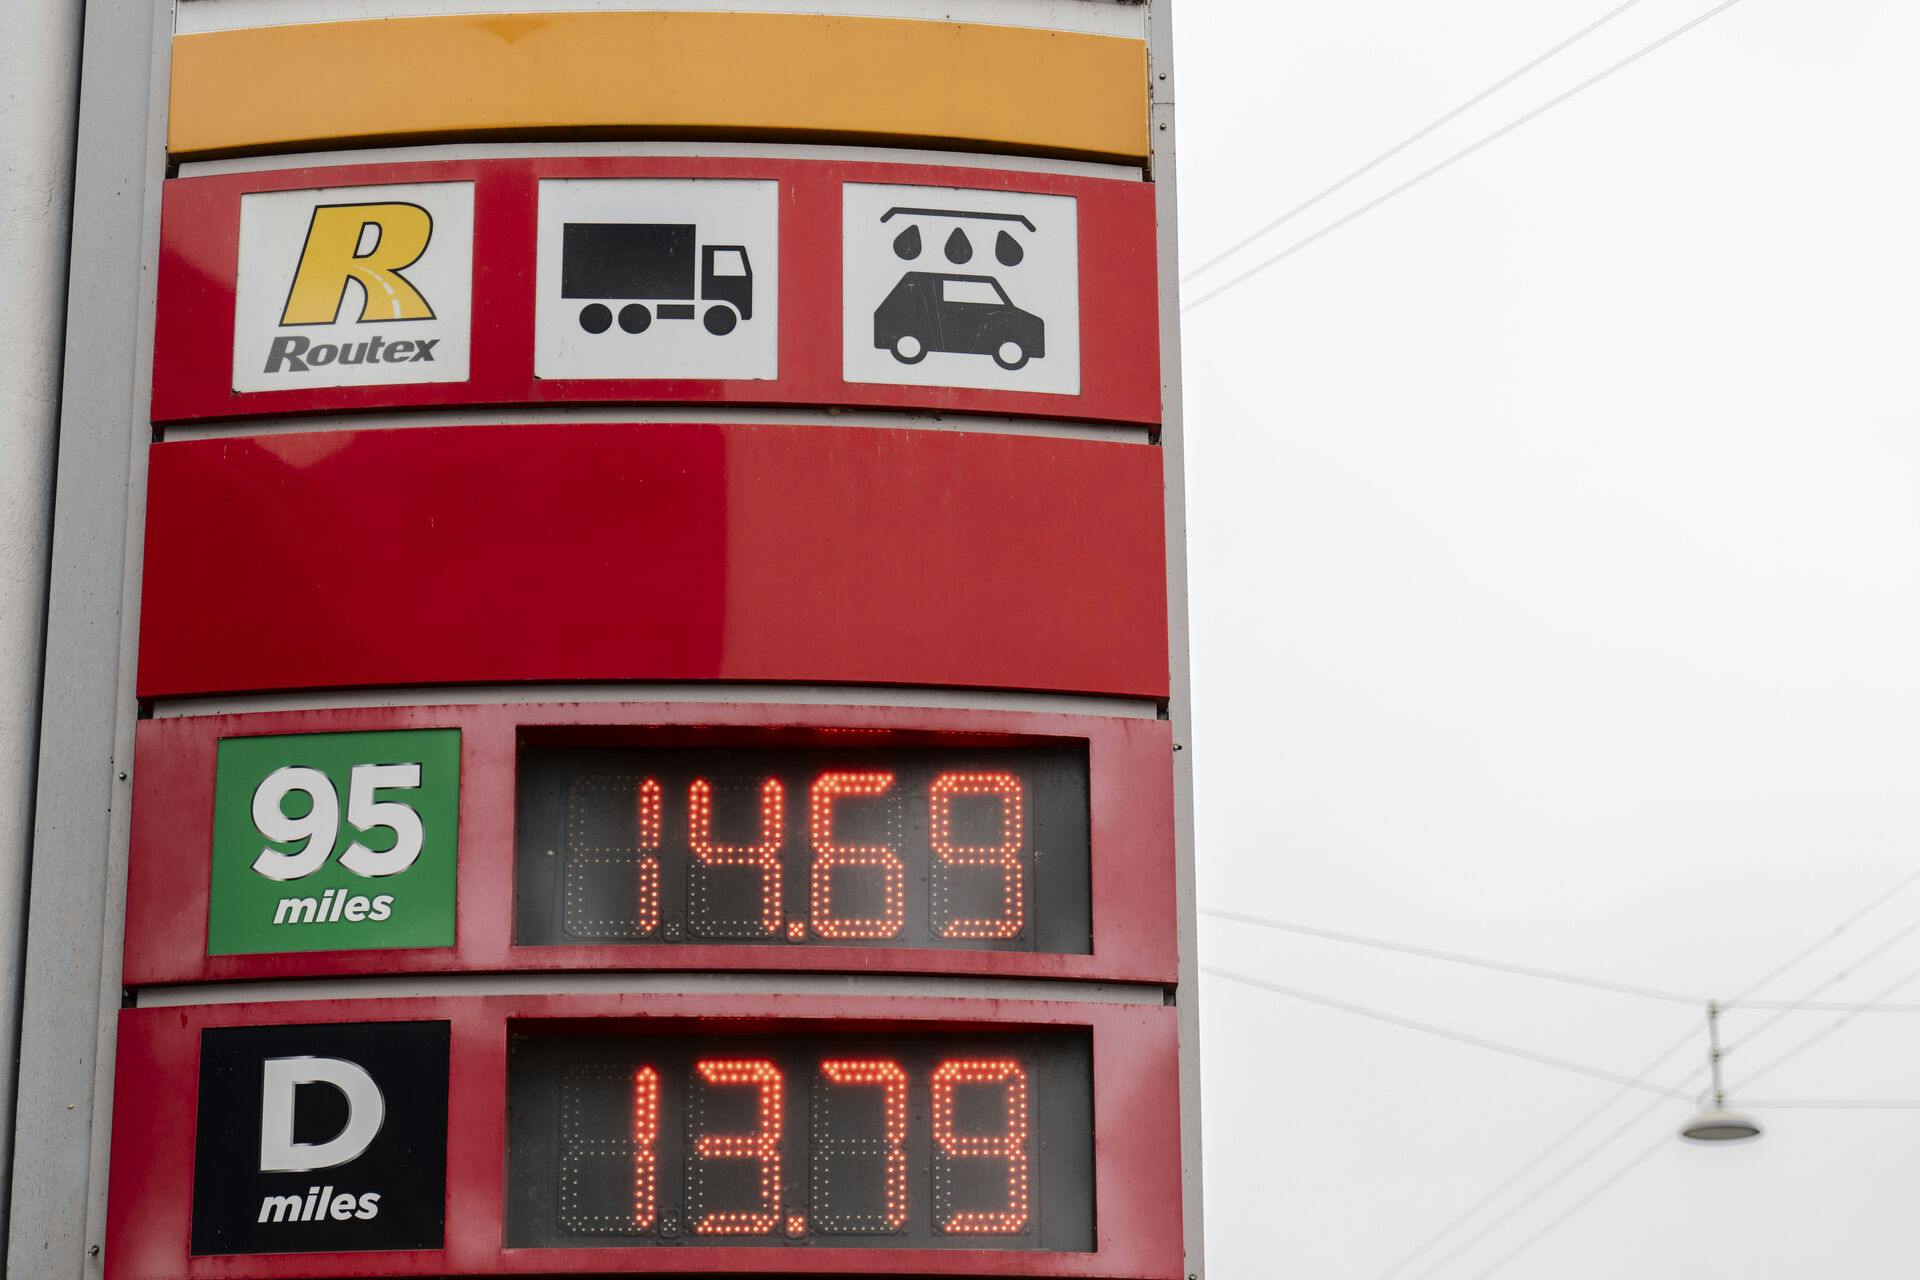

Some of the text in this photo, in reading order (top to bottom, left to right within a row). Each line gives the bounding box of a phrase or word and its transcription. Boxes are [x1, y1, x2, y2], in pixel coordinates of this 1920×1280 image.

[278, 201, 437, 327] R
[263, 336, 440, 373] Routex
[251, 762, 424, 881] 95
[639, 770, 1024, 939] 14.69
[273, 888, 394, 924] miles
[258, 1055, 386, 1173] D
[634, 1058, 1029, 1234] 13.79
[258, 1186, 381, 1223] miles
